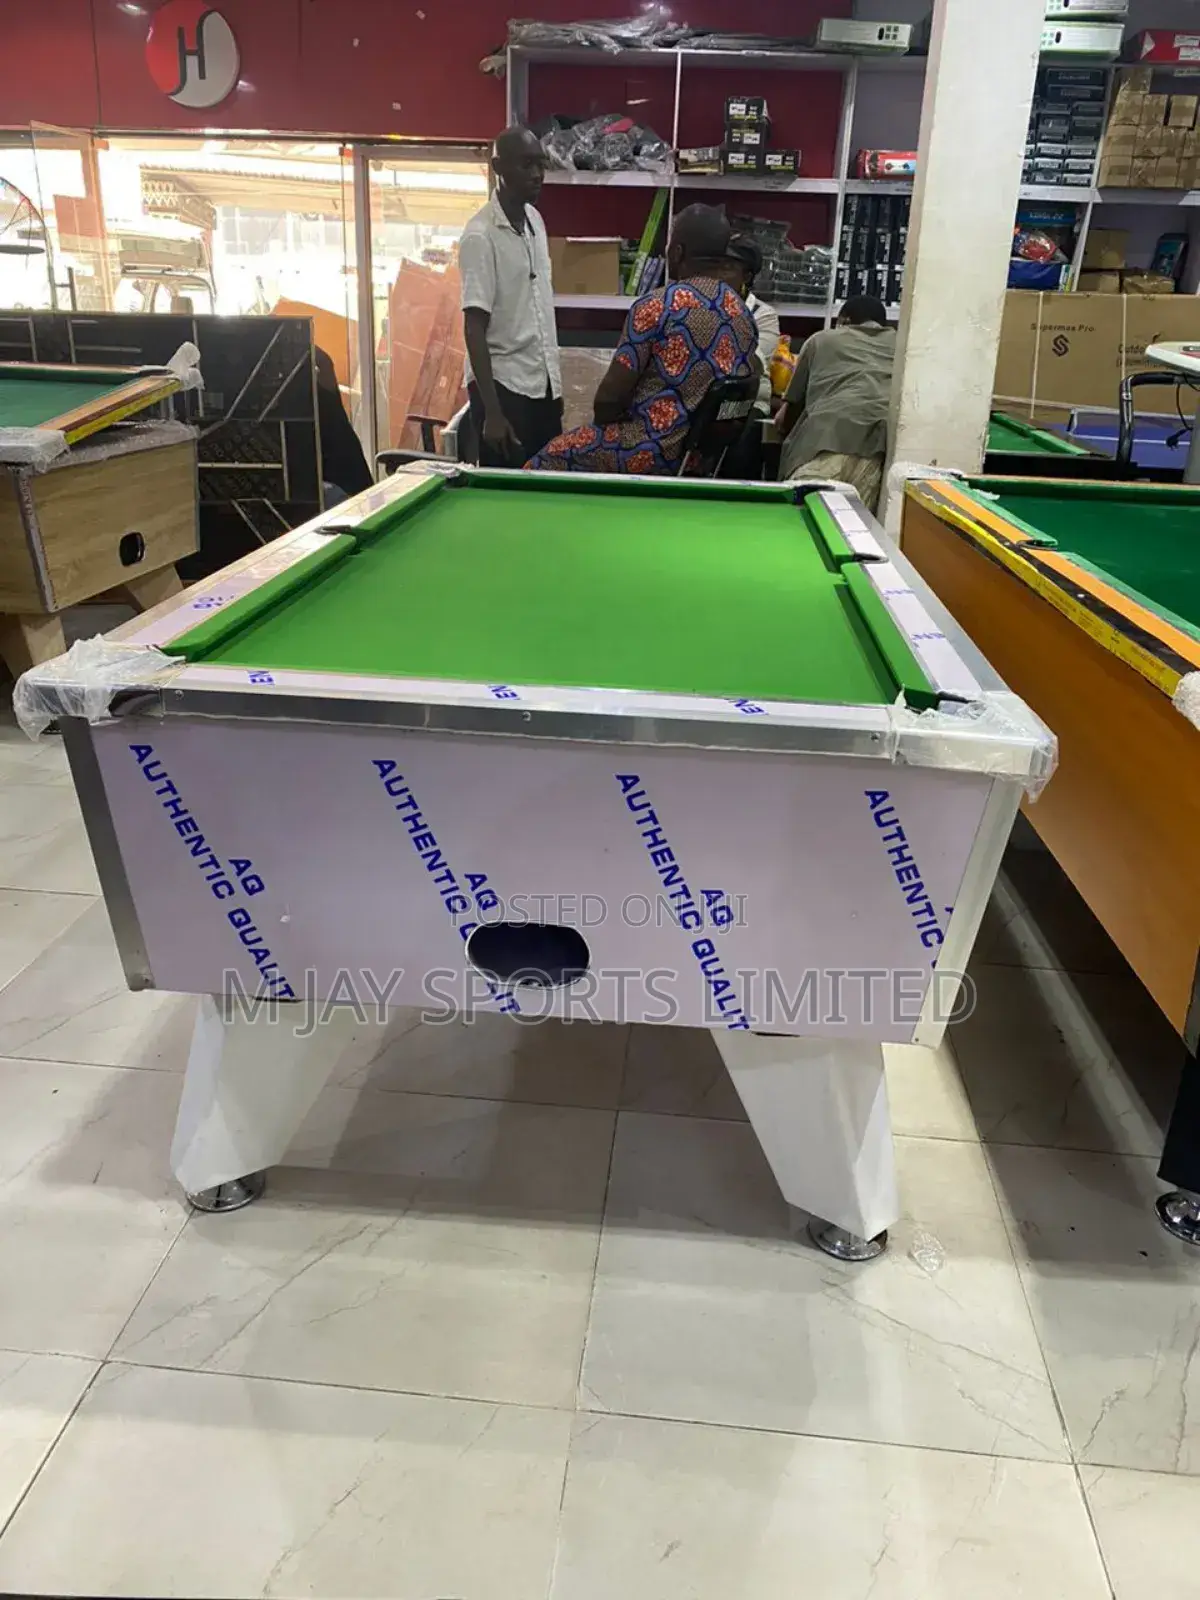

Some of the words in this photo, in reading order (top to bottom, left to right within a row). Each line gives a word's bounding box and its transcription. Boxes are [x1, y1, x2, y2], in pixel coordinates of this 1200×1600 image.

[129, 743, 235, 900] AUTHENTIC
[227, 908, 297, 998] QUALIT
[228, 856, 266, 897] AQ
[372, 759, 471, 915] AUTHENTIC
[464, 873, 498, 912] AQ
[616, 773, 703, 930] AUTHENTIC
[690, 938, 750, 1031] QUALIT
[700, 888, 734, 928] AQ
[865, 789, 944, 949] AUTHENTIC
